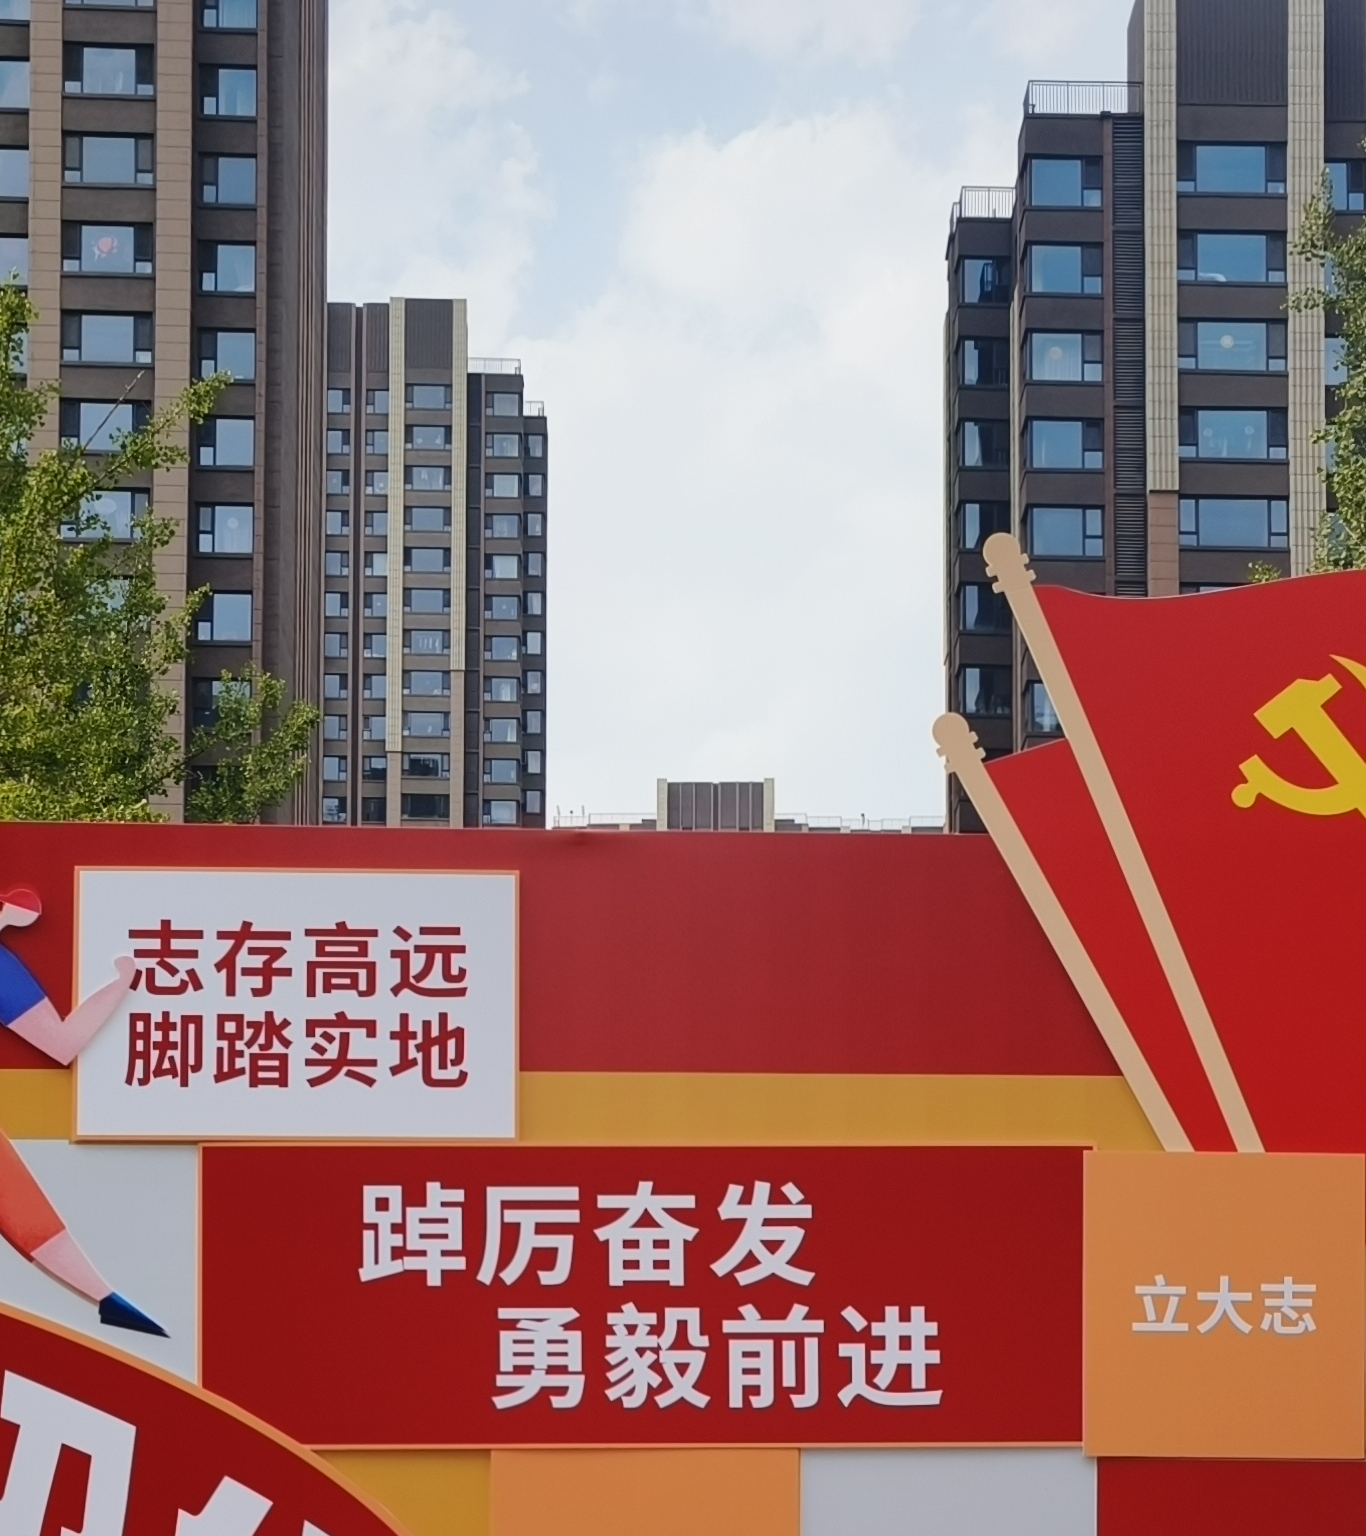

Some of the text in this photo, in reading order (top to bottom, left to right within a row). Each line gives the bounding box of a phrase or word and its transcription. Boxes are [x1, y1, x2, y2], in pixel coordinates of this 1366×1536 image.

[126, 918, 469, 998] 志存高远
[124, 1010, 469, 1090] 脚踏实地
[357, 1181, 816, 1288] 踔厉奋发
[1131, 1274, 1318, 1335] 立大志
[490, 1301, 944, 1410] 勇毅前进
